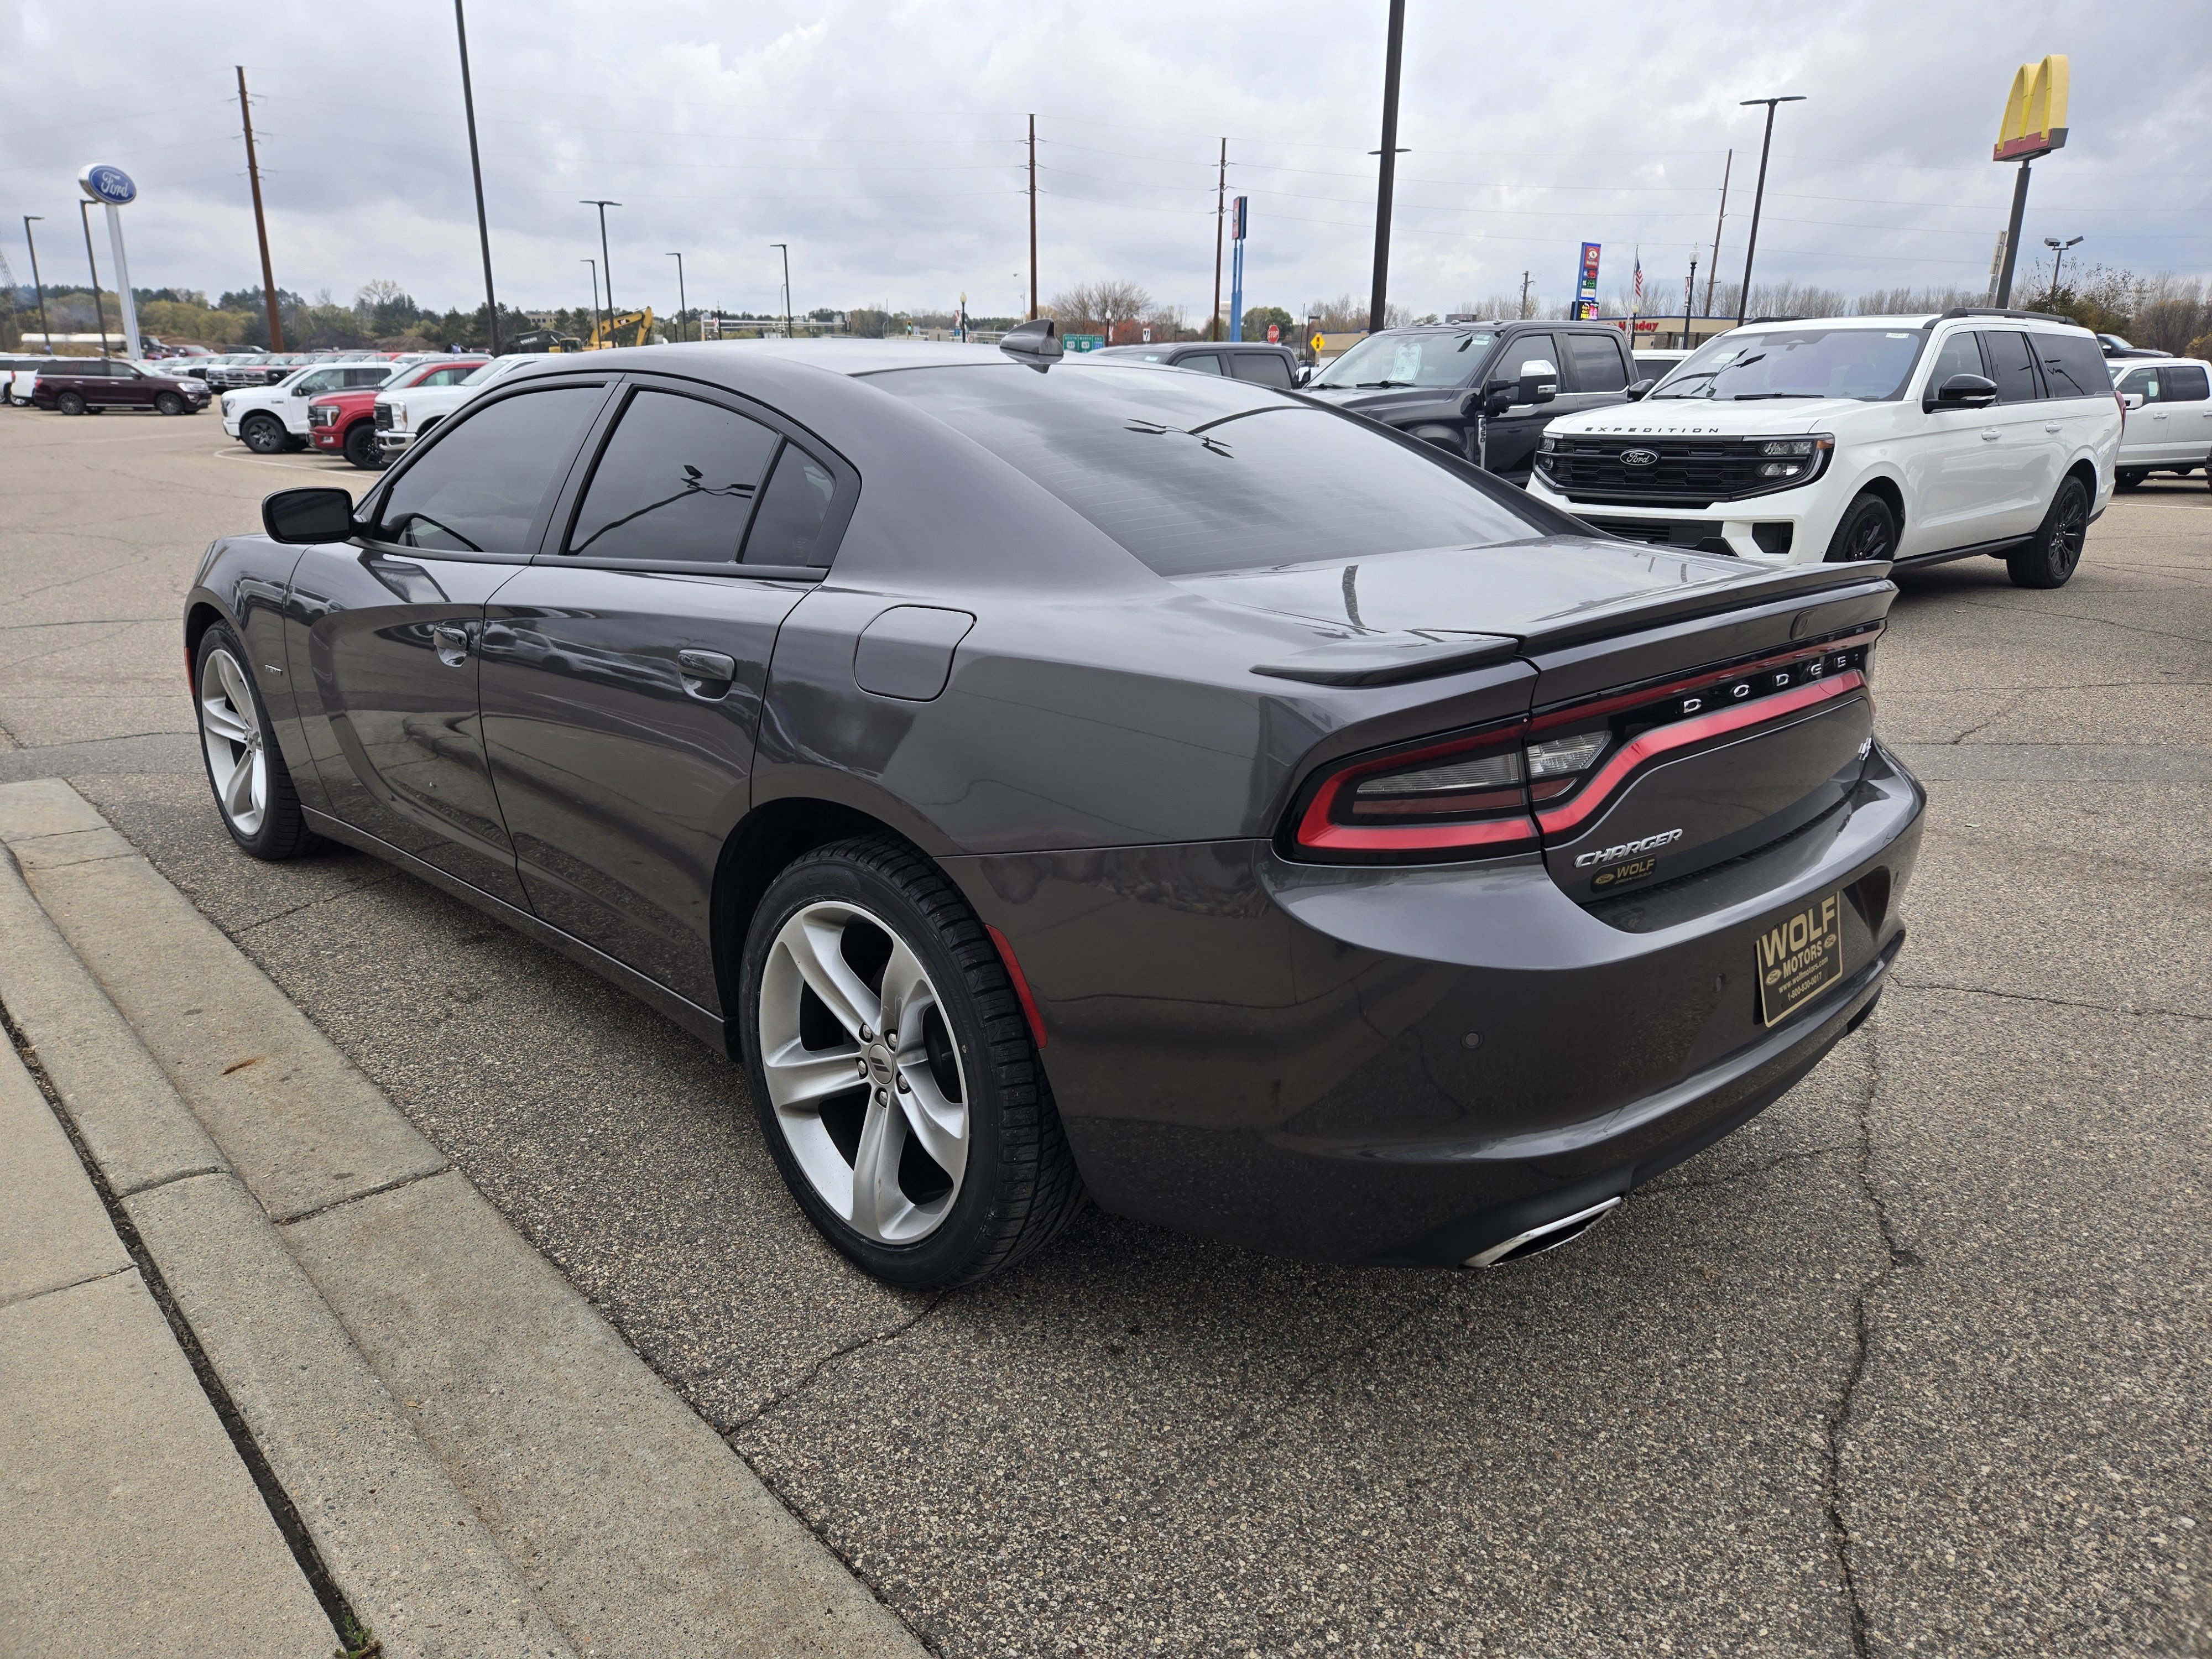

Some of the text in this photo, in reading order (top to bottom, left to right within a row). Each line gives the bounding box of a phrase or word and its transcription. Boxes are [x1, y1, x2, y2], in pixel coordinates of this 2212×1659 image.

[101, 172, 129, 198] Ford
[1626, 452, 1650, 463] Ford
[1683, 655, 1846, 714] DODGE
[1574, 828, 1683, 868] CHARGER
[1617, 858, 1655, 878] WOLF
[1761, 895, 1835, 968] WOLF
[1778, 956, 1828, 993] www.wolfmotors.com
[1783, 940, 1822, 979] MOTORS
